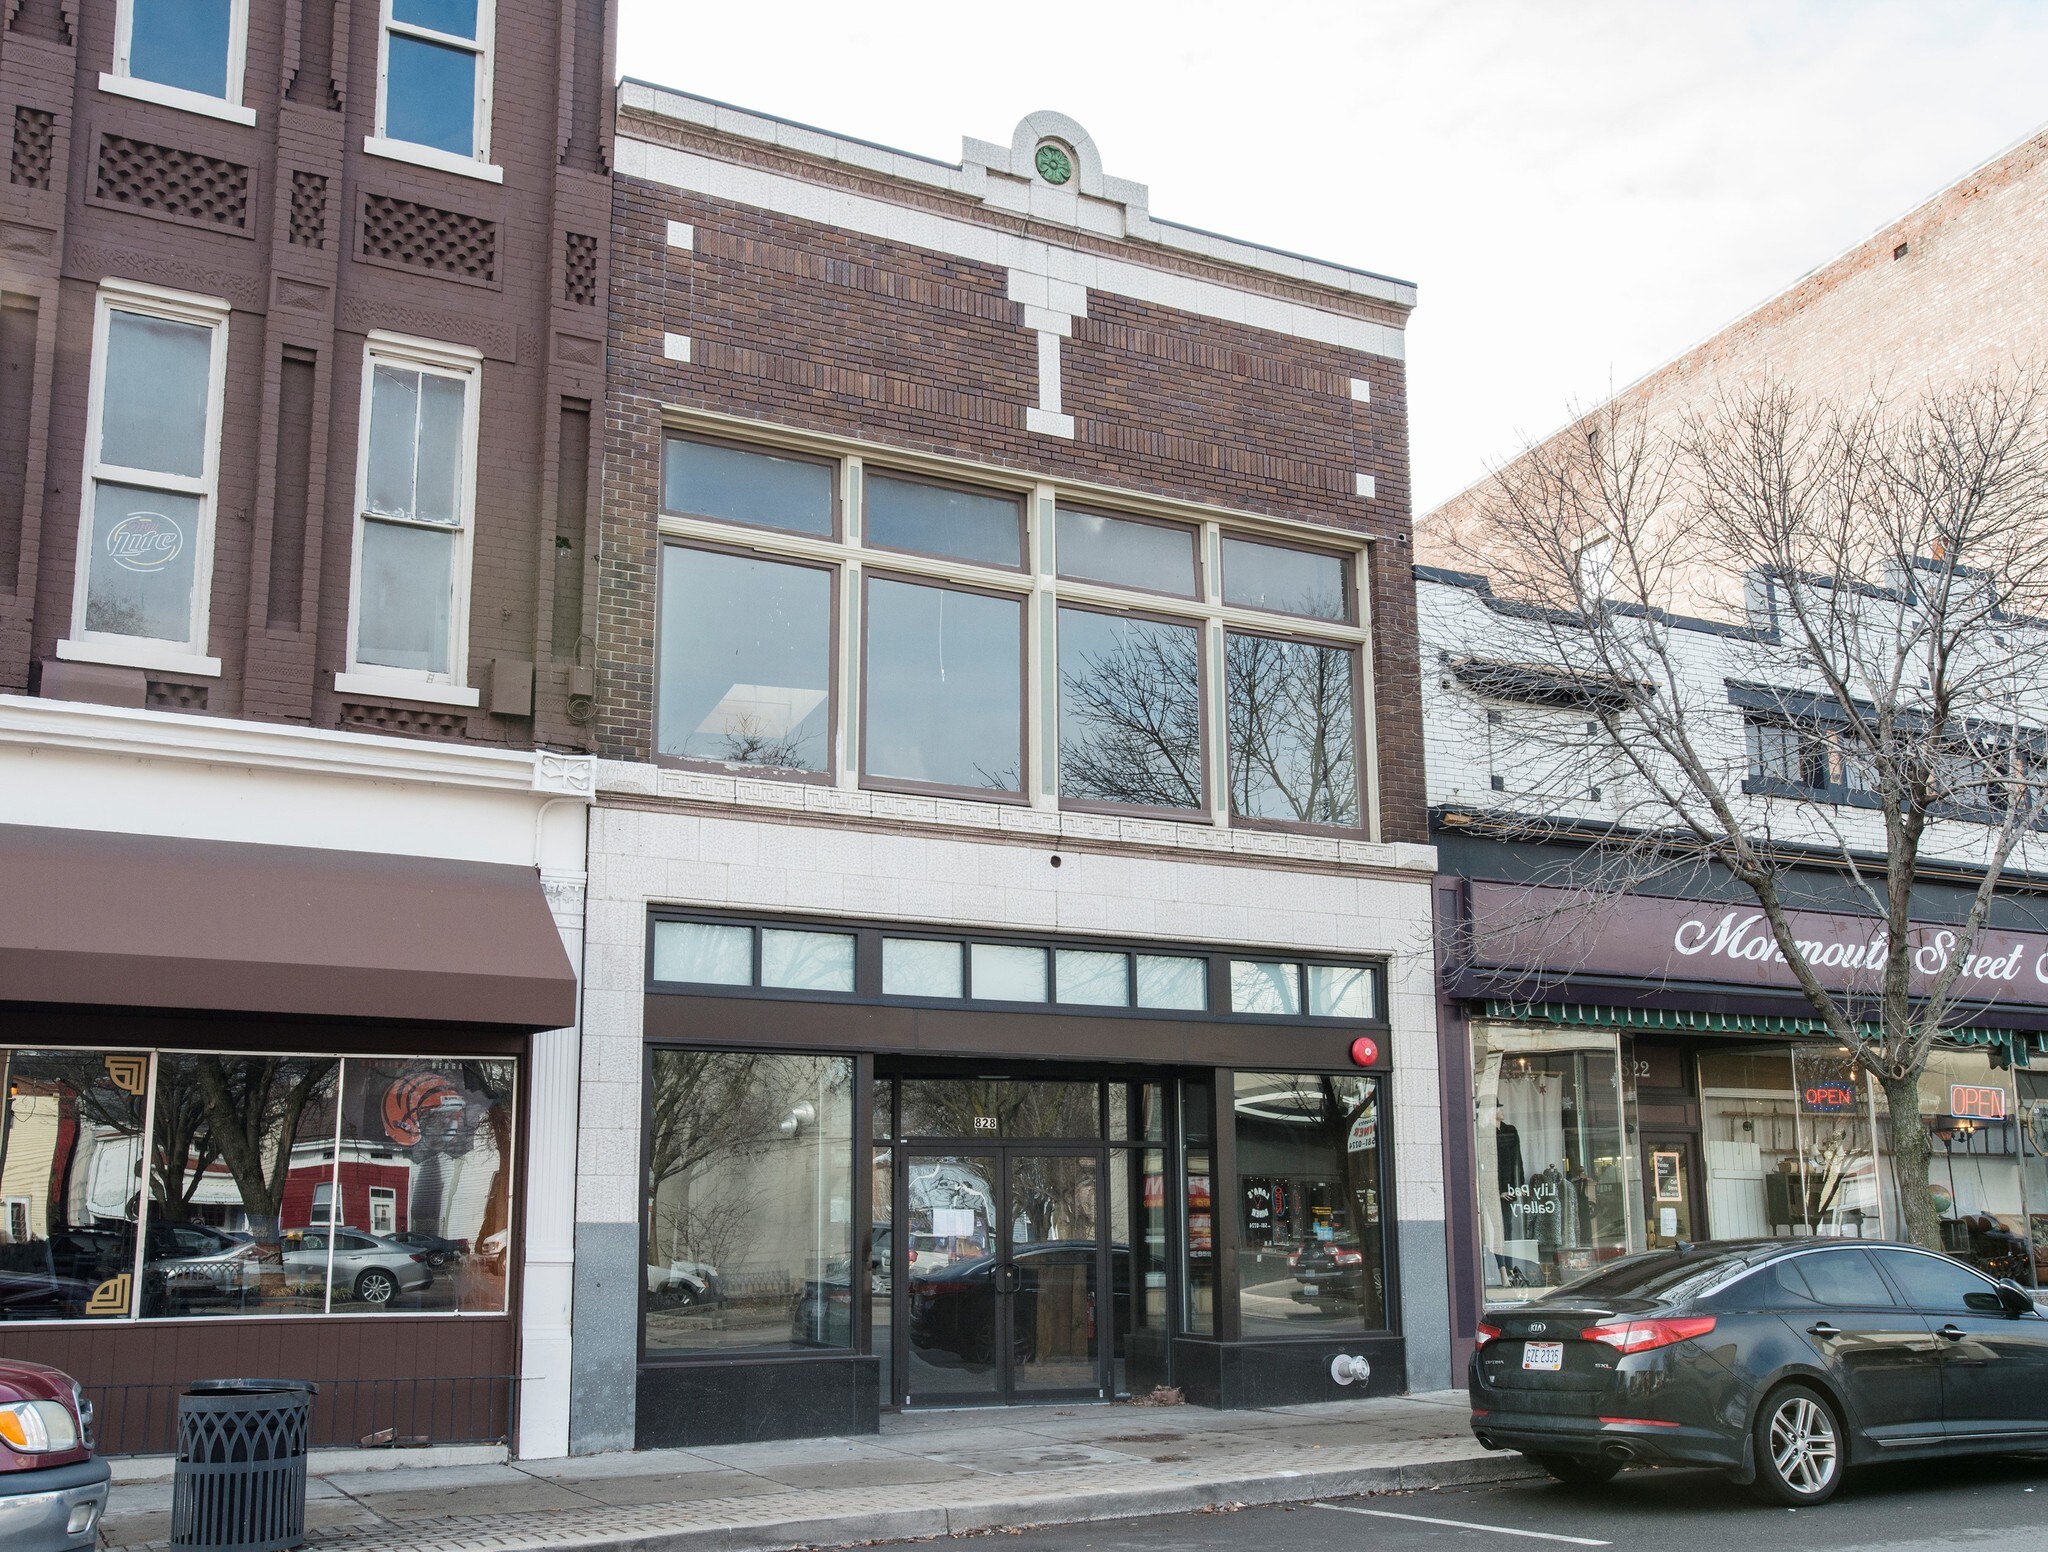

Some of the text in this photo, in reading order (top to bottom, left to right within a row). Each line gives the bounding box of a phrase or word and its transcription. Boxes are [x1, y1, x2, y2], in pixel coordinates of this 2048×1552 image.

[108, 530, 178, 557] Lite
[1674, 911, 1889, 970] Monmout
[1915, 930, 2023, 981] Sreet
[1805, 1088, 1851, 1105] OPEN
[1951, 1086, 2004, 1119] OPEN
[975, 1117, 996, 1128] 828
[1526, 1349, 1560, 1363] GZE 2335
